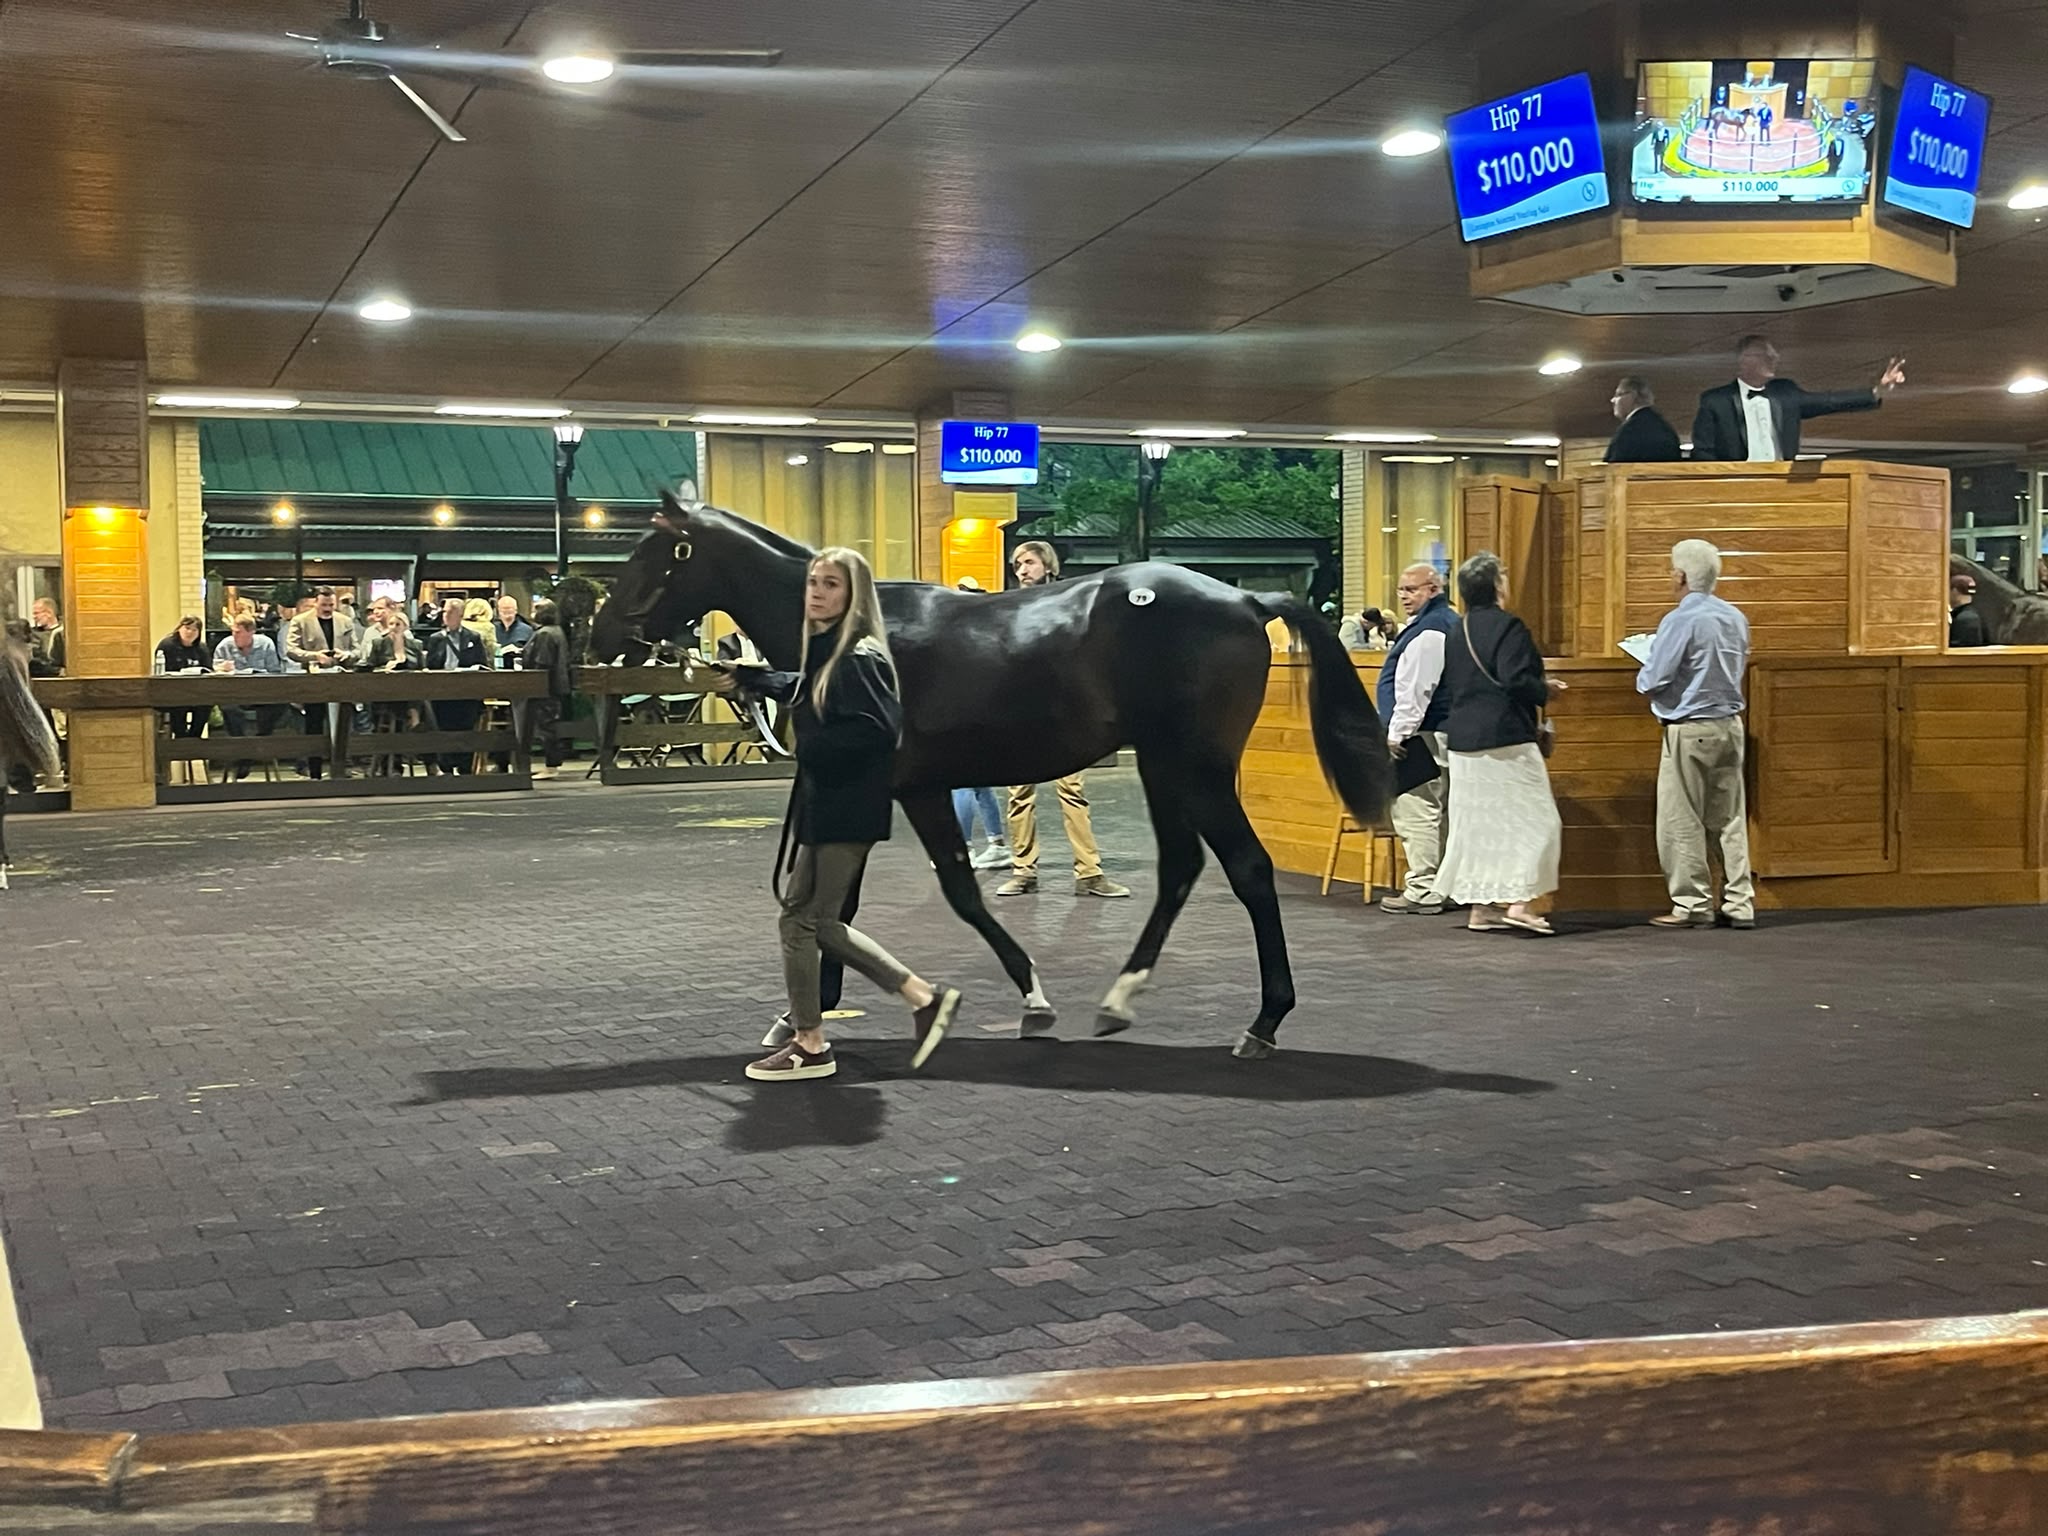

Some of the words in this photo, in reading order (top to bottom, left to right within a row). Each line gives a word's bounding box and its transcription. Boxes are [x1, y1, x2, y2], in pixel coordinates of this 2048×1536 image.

[1489, 103, 1521, 132] Hip
[1522, 93, 1542, 121] 77
[1931, 83, 1952, 117] Hip
[1952, 92, 1967, 117] 77
[1477, 137, 1574, 195] $110,000
[1908, 127, 1969, 179] $110,000
[974, 426, 994, 440] Hip
[995, 426, 1009, 439] 77
[960, 447, 1022, 465] $110,000
